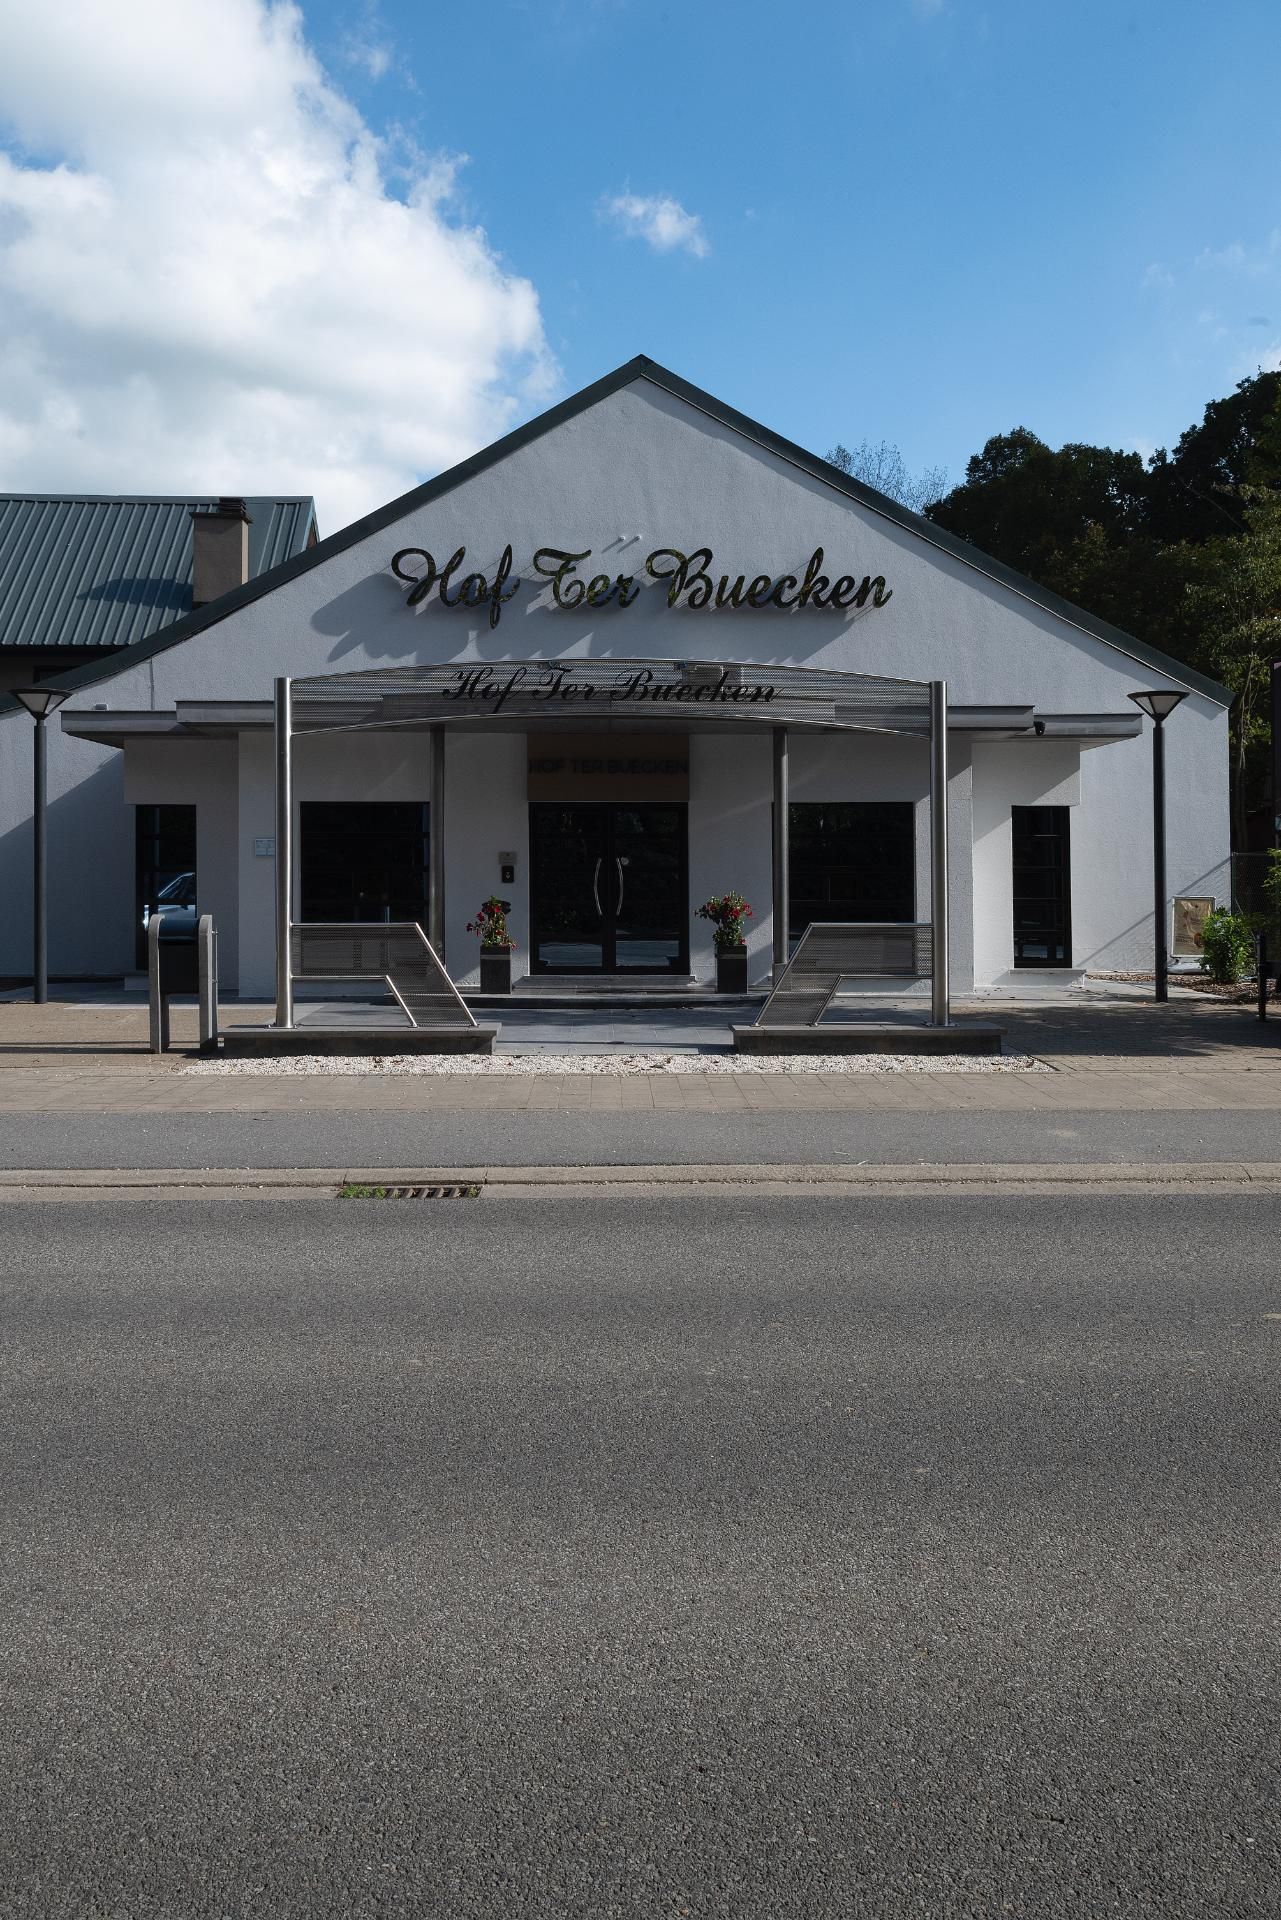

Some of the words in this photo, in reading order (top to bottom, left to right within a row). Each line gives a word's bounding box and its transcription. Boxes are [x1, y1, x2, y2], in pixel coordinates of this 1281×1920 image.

[391, 544, 520, 630] Hof
[533, 547, 640, 609] Ter
[645, 546, 892, 609] Buecken
[442, 667, 527, 714] Hof
[532, 664, 600, 701] Ter
[608, 667, 785, 703] Buecken
[528, 759, 562, 774] HOF
[607, 759, 688, 774] BUECKEN
